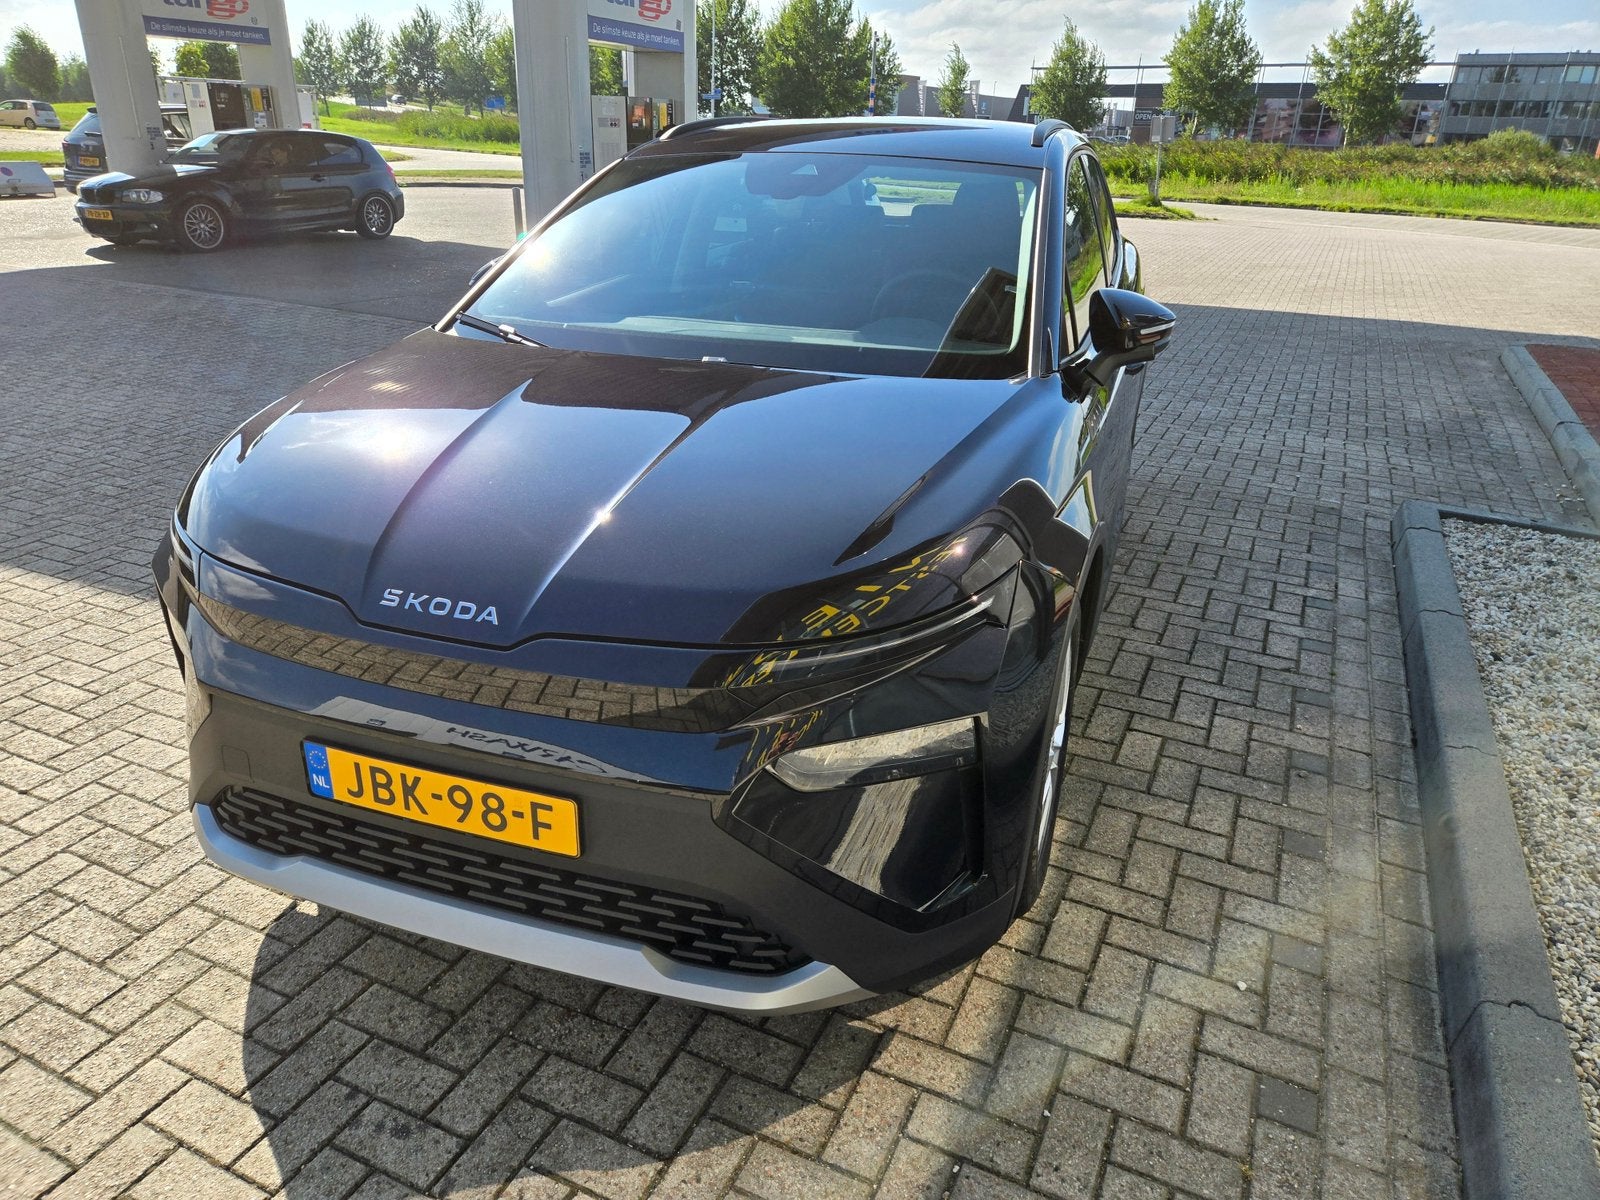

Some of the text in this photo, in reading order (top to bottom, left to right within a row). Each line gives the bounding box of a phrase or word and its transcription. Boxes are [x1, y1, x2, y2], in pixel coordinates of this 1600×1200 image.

[151, 21, 161, 31] De
[162, 23, 187, 33] slimste
[188, 26, 207, 35] keuze
[208, 27, 218, 36] als
[218, 29, 225, 38] je
[225, 30, 242, 38] moet
[593, 22, 601, 33] De
[602, 24, 621, 37] slimste
[621, 28, 637, 39] keuze
[637, 31, 645, 40] als
[644, 32, 650, 43] je
[650, 33, 663, 43] moet
[312, 773, 330, 789] NL
[347, 761, 553, 840] JBK-98-F
